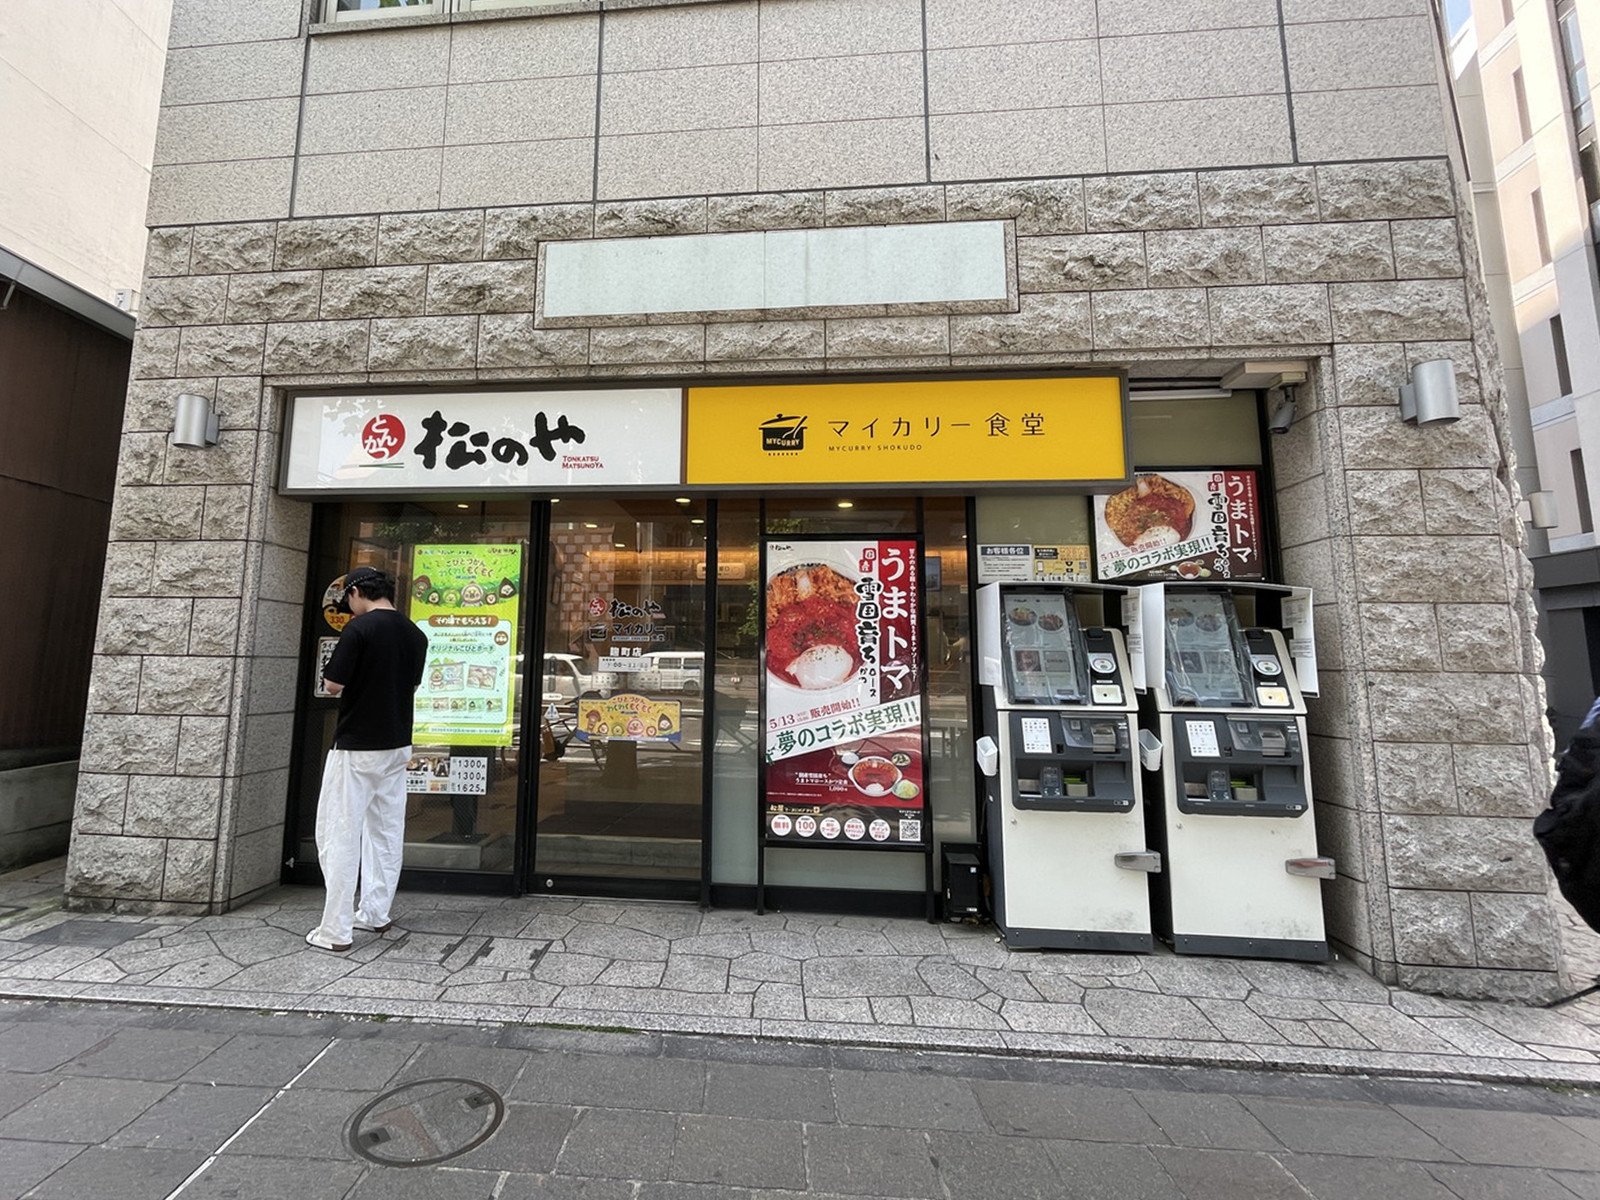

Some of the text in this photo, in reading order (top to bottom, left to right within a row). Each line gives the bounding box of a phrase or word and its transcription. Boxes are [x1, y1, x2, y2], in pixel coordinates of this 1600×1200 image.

[363, 415, 404, 460] とんかつ
[413, 410, 586, 470] 松のや
[765, 437, 800, 447] MYCURRY
[828, 443, 923, 452] MYCURRY SHOKUDO
[1228, 475, 1252, 563] うまトマ
[881, 548, 911, 690] うまトマ
[769, 714, 796, 730] 5/13
[776, 700, 921, 757] 夢のコラボ実現!!
[809, 697, 862, 719] 販売開始!!
